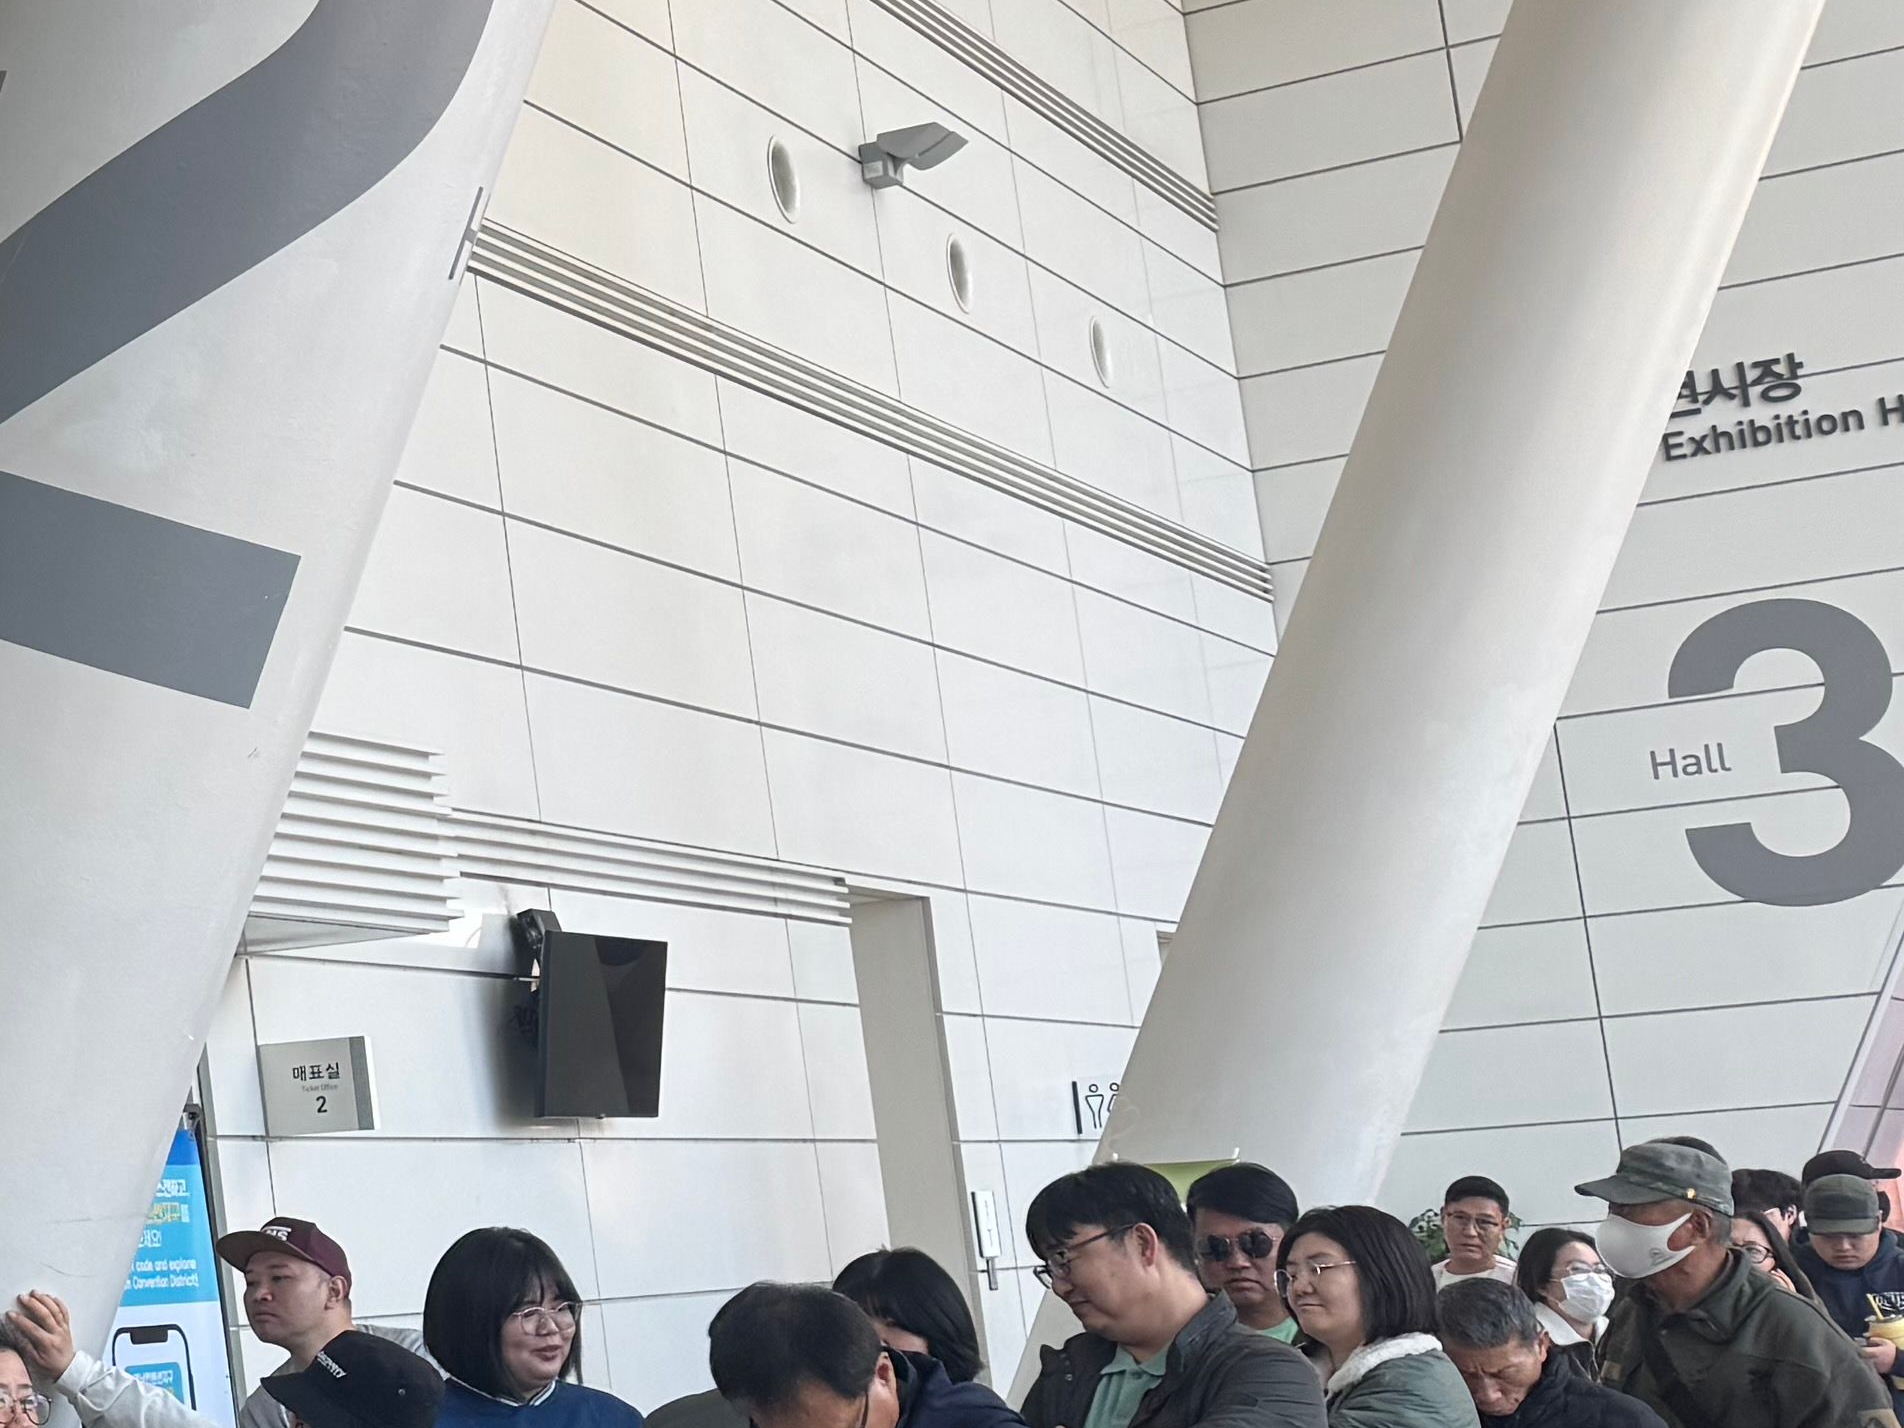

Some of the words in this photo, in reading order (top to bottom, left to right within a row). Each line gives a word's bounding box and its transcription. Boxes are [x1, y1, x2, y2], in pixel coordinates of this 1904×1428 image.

[1662, 409, 1865, 462] Exhibition
[1649, 742, 1732, 780] Hall
[1667, 598, 1904, 907] 3
[292, 1062, 340, 1081] 매표실
[316, 1095, 328, 1113] 2
